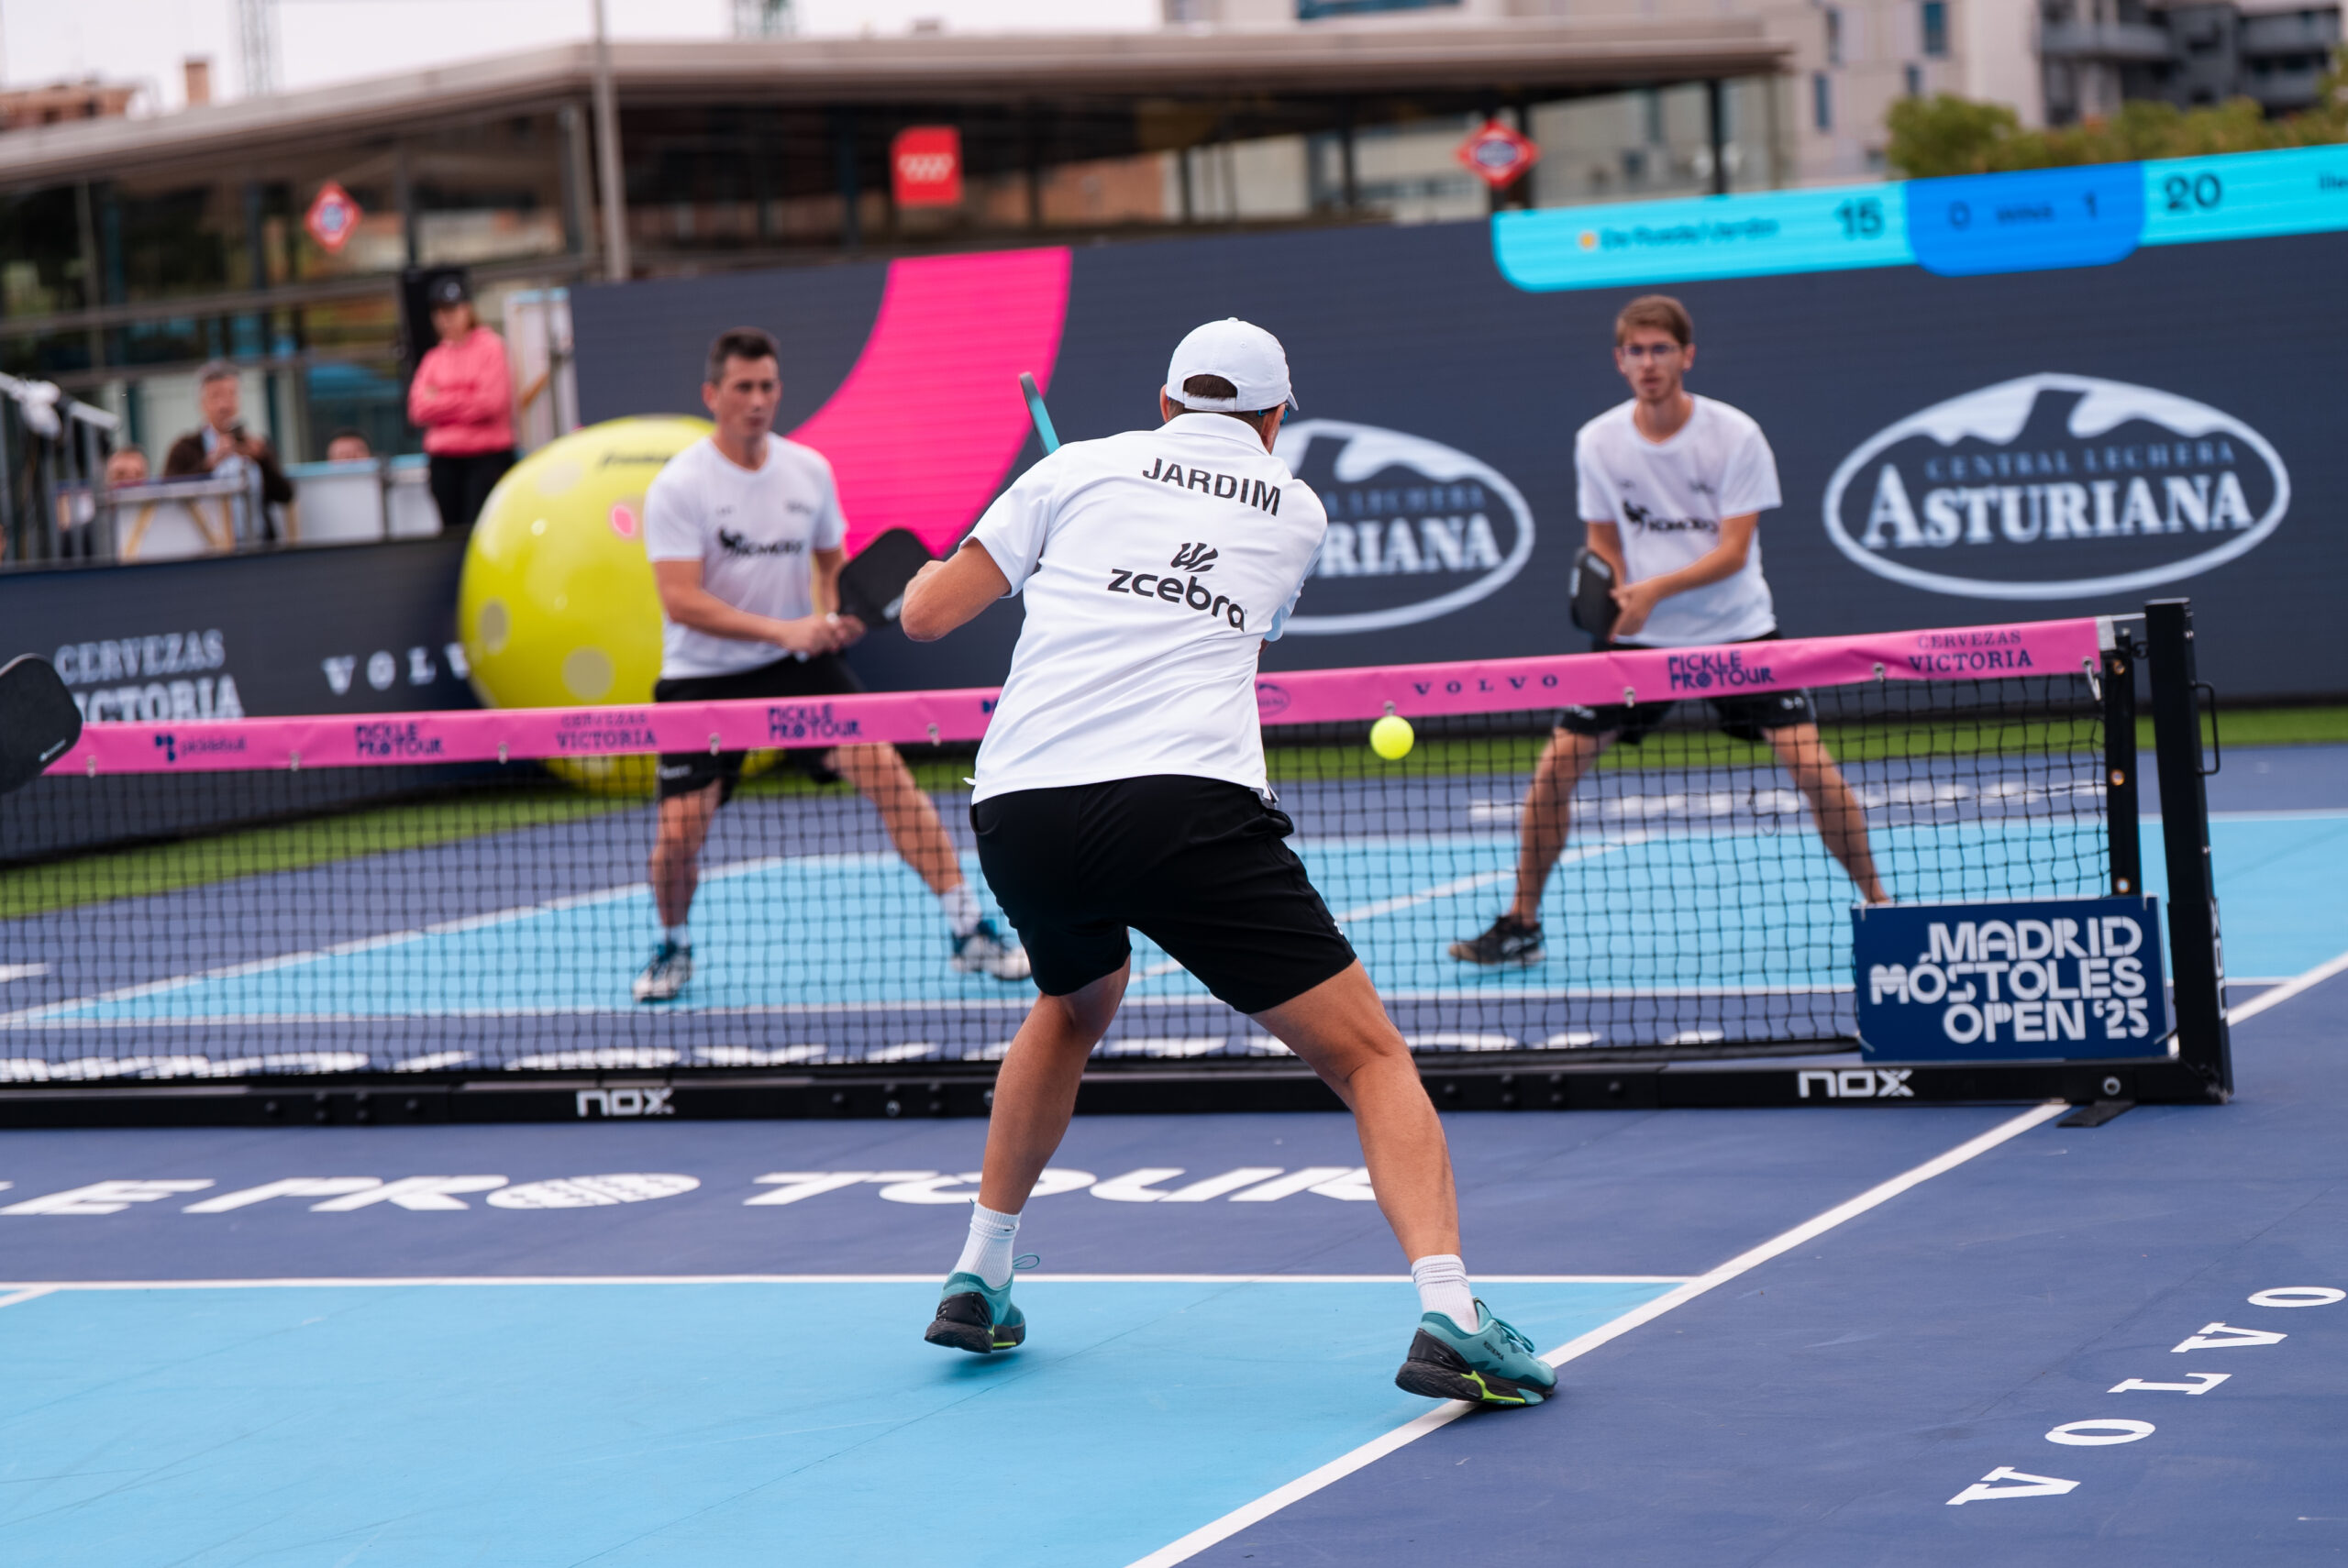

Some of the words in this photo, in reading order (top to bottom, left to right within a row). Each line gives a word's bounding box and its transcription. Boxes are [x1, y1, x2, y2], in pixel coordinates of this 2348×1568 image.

[2083, 191, 2098, 219] 1
[2165, 172, 2221, 212] 20
[1838, 197, 1885, 240] 15
[1948, 200, 1971, 229] 0
[1927, 448, 2072, 482] CENTRAL
[2083, 440, 2236, 473] LECHERA
[1143, 458, 1281, 516] JARDIM
[1860, 462, 2254, 549] ASTURIANA
[1317, 513, 1502, 578] RIANA
[1107, 569, 1246, 633] zcebra
[53, 628, 226, 685] CERVEZAS
[1908, 648, 2033, 673] VICTORIA
[1918, 629, 2022, 650] CERVEZAS
[1668, 649, 1742, 674] PICKLE
[72, 674, 245, 723] ICTORIA
[1412, 674, 1558, 696] VOLVO
[555, 729, 658, 750] VICTORIA
[1929, 916, 2143, 963] MADRID
[1868, 952, 2147, 1006] MÓSTOLES
[1942, 1000, 2087, 1044] OPEN
[1944, 1286, 2348, 1506] VOLVO
